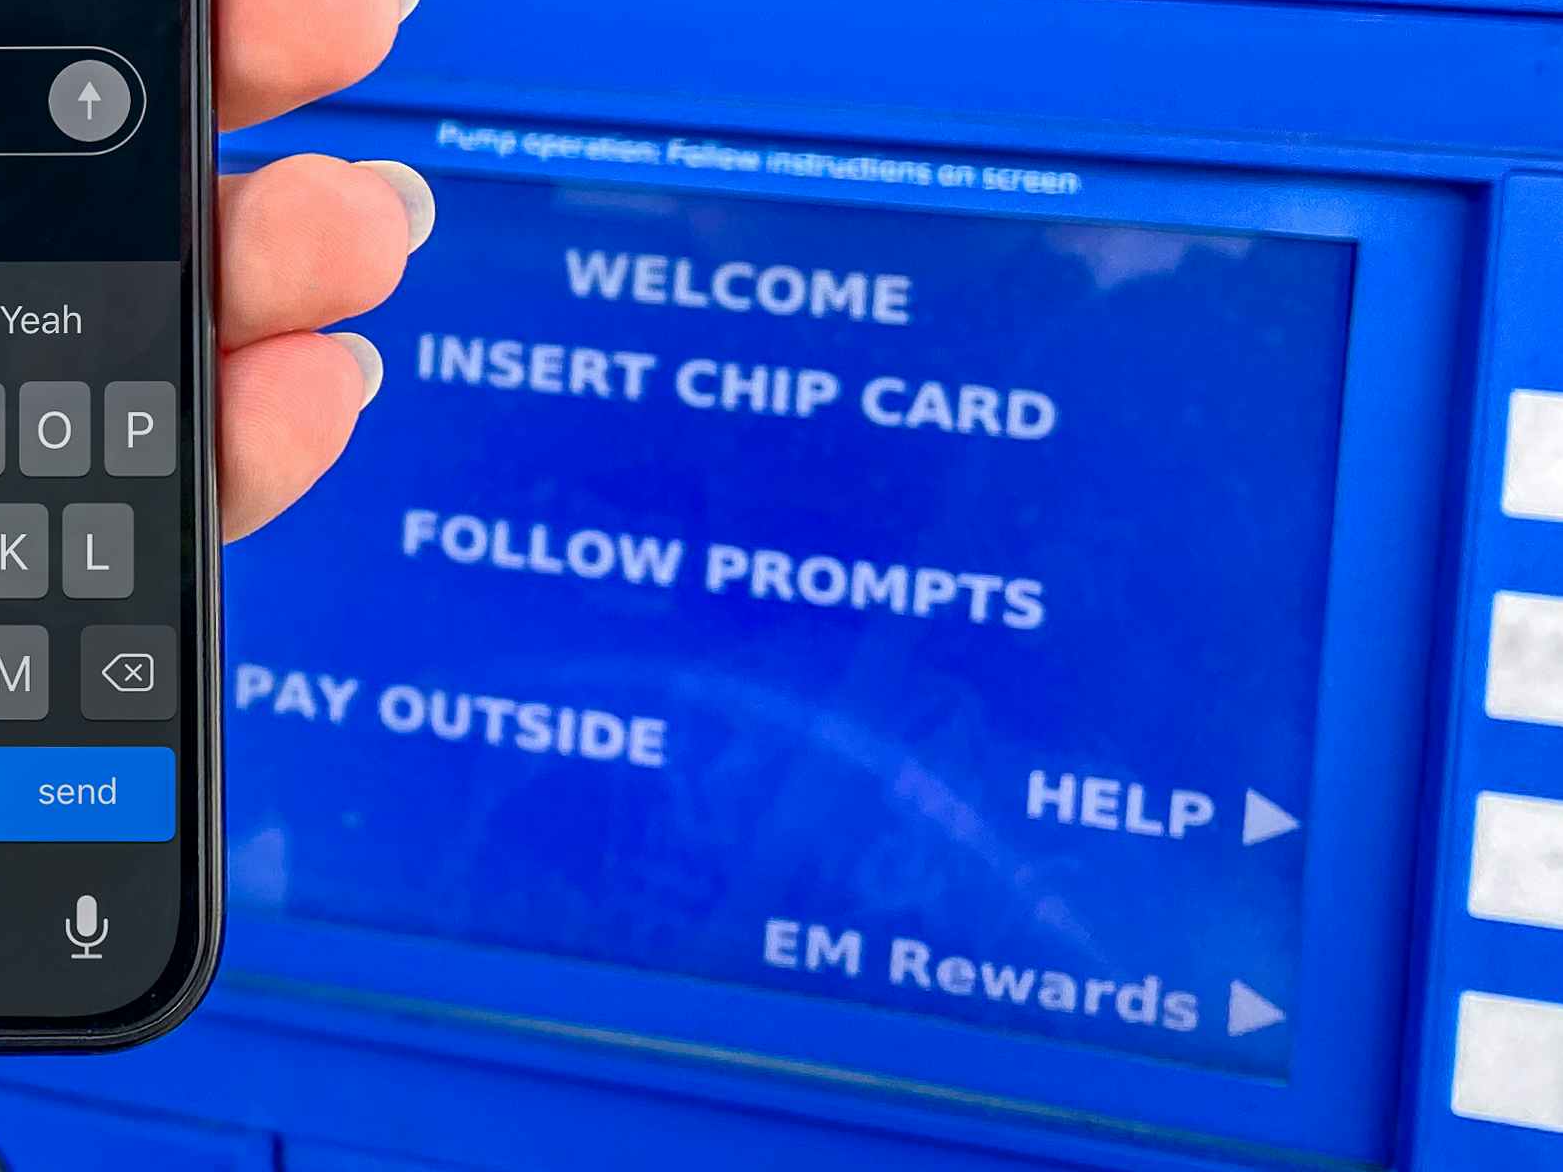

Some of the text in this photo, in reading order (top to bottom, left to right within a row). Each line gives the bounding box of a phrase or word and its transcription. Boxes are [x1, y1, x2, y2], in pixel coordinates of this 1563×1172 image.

[439, 123, 518, 157] Pump
[667, 138, 761, 172] Follow
[766, 149, 931, 187] instructions
[937, 163, 975, 188] on
[982, 165, 1082, 196] screen
[0, 304, 82, 335] Yeah
[565, 249, 913, 326] WELCOME
[416, 333, 1058, 442] INSERT CHIP CARD
[38, 411, 71, 449] O
[128, 411, 154, 448] P
[0, 533, 28, 570] K
[86, 533, 109, 570] L
[401, 509, 1046, 630] FOLLOW PROMPTS
[235, 663, 669, 769] PAY OUTSIDE
[38, 776, 117, 805] send
[1026, 769, 1216, 841] HELP
[763, 917, 1201, 1034] EM Rewards
